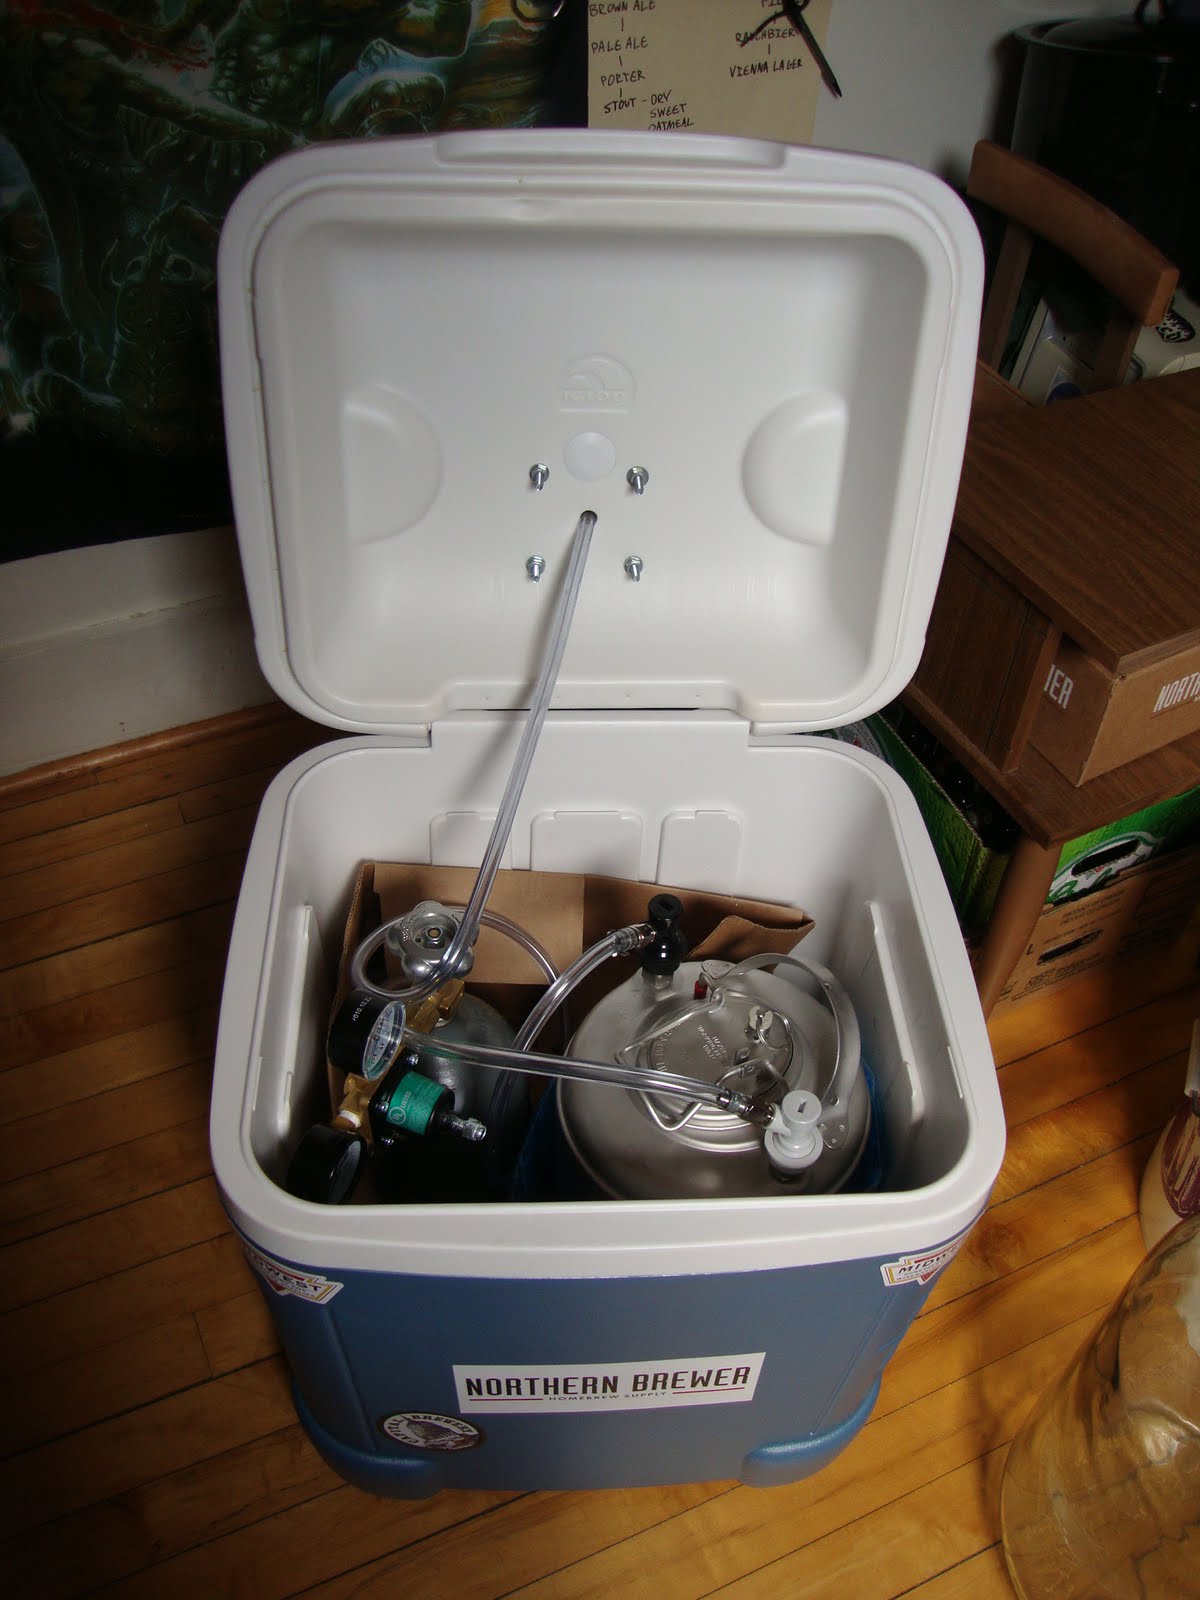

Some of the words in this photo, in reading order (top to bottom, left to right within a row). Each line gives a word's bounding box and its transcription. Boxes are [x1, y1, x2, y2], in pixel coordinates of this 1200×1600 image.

[589, 1, 628, 17] BROWN
[633, 0, 656, 12] ALE
[735, 28, 796, 43] RACHBIER
[591, 40, 622, 54] PALE
[626, 36, 648, 50] ALE
[729, 64, 769, 78] VIENNA
[772, 58, 803, 71] LAGER
[600, 70, 646, 86] PORTER
[603, 98, 637, 114] STOUT
[649, 103, 687, 119] SWEET
[465, 1375, 619, 1397] NORTHERN
[631, 1366, 751, 1393] BREWER
